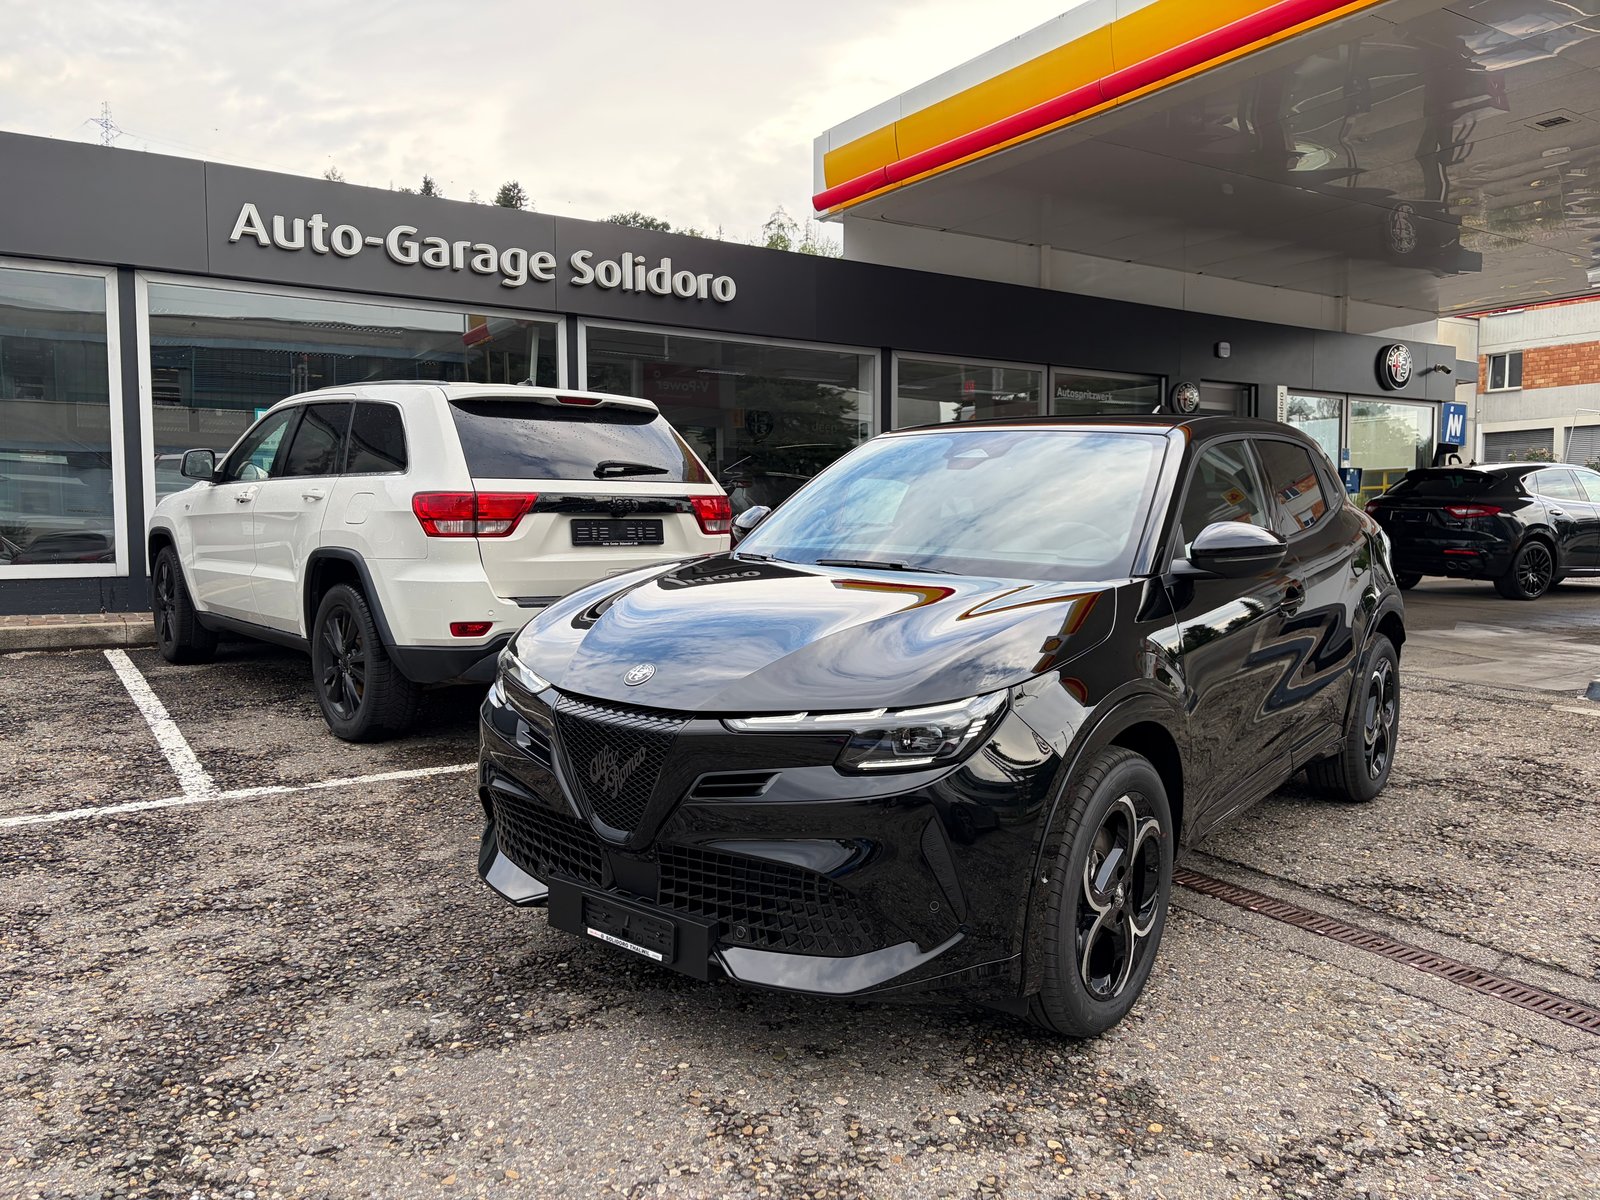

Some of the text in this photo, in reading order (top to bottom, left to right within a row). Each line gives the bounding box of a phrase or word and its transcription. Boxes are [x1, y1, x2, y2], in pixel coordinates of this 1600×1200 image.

[229, 203, 737, 302] Auto-Garage Solidoro
[1056, 387, 1113, 401] Autospritzwerk
[608, 498, 639, 513] Jeep
[605, 746, 647, 799] Romeo
[606, 935, 629, 948] SOLIDORO
[629, 944, 650, 956] THALWIL
